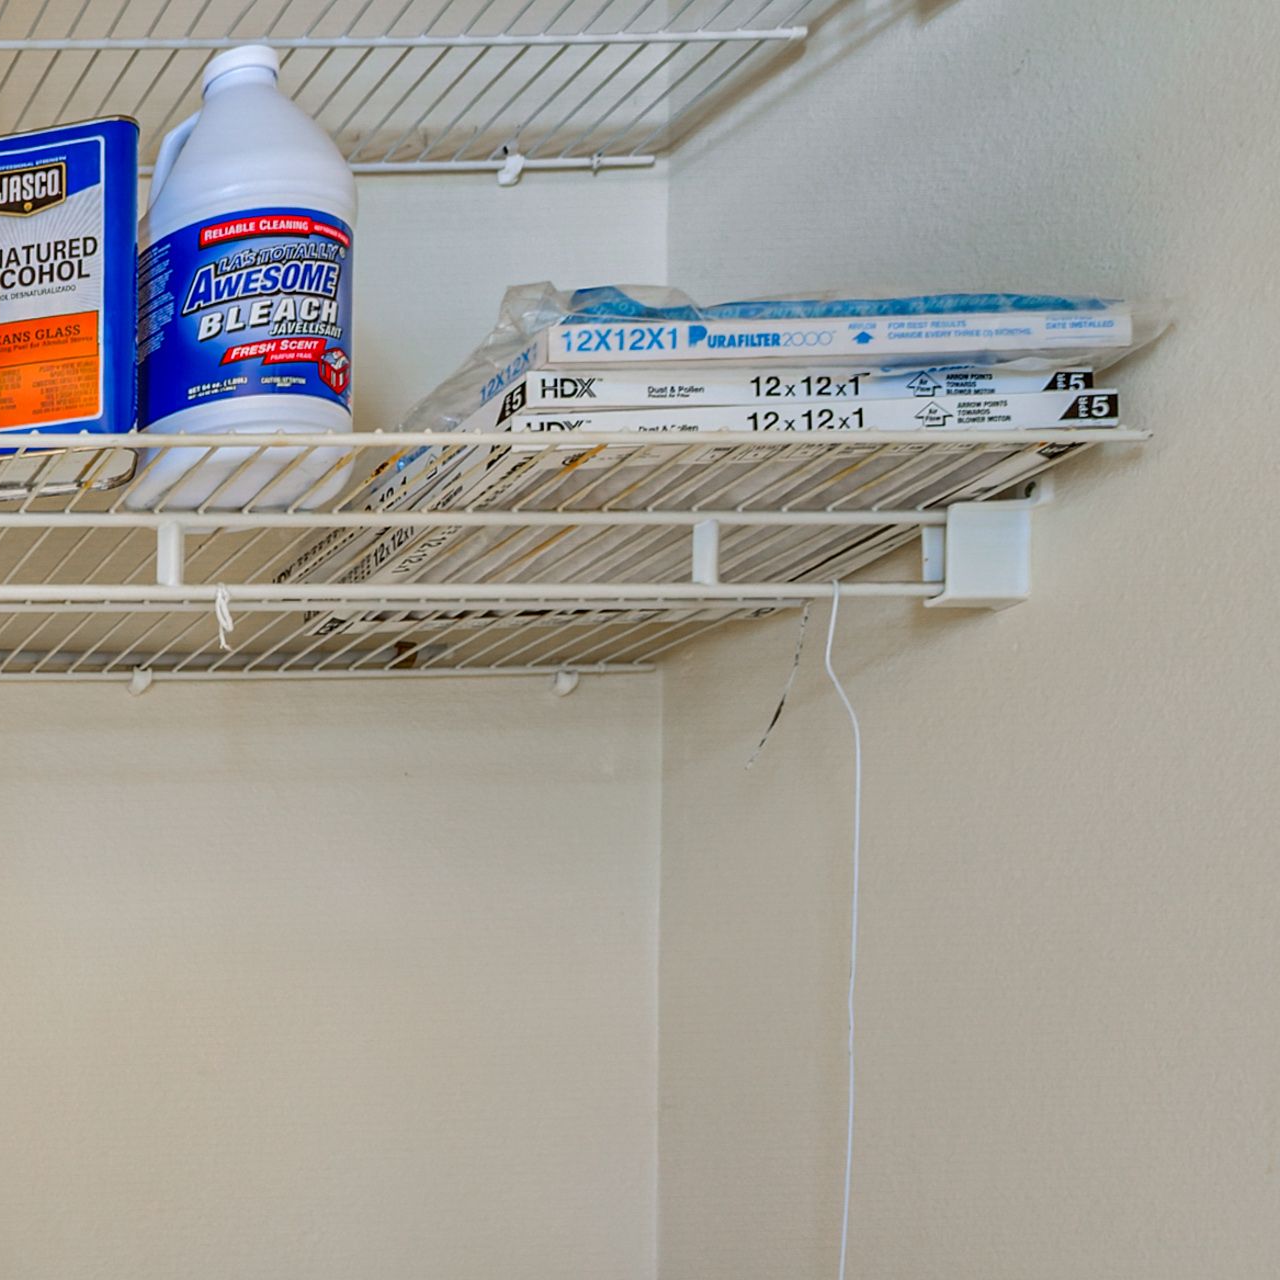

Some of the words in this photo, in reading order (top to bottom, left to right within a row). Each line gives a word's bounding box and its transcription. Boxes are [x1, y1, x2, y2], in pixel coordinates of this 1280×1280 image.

[203, 221, 256, 241] RELIABLE
[258, 219, 309, 231] CLEANING
[182, 260, 340, 316] AWESOME
[197, 296, 339, 342] BLEACH
[269, 320, 342, 339] JAVELLISANT
[34, 324, 81, 341] GLASS
[561, 327, 678, 351] 12X12X1
[230, 341, 277, 360] FRESH
[279, 339, 319, 350] SCENT
[540, 377, 597, 399] HDX
[647, 385, 667, 394] Dust
[678, 385, 705, 394] Pollen
[1092, 395, 1110, 416] 5
